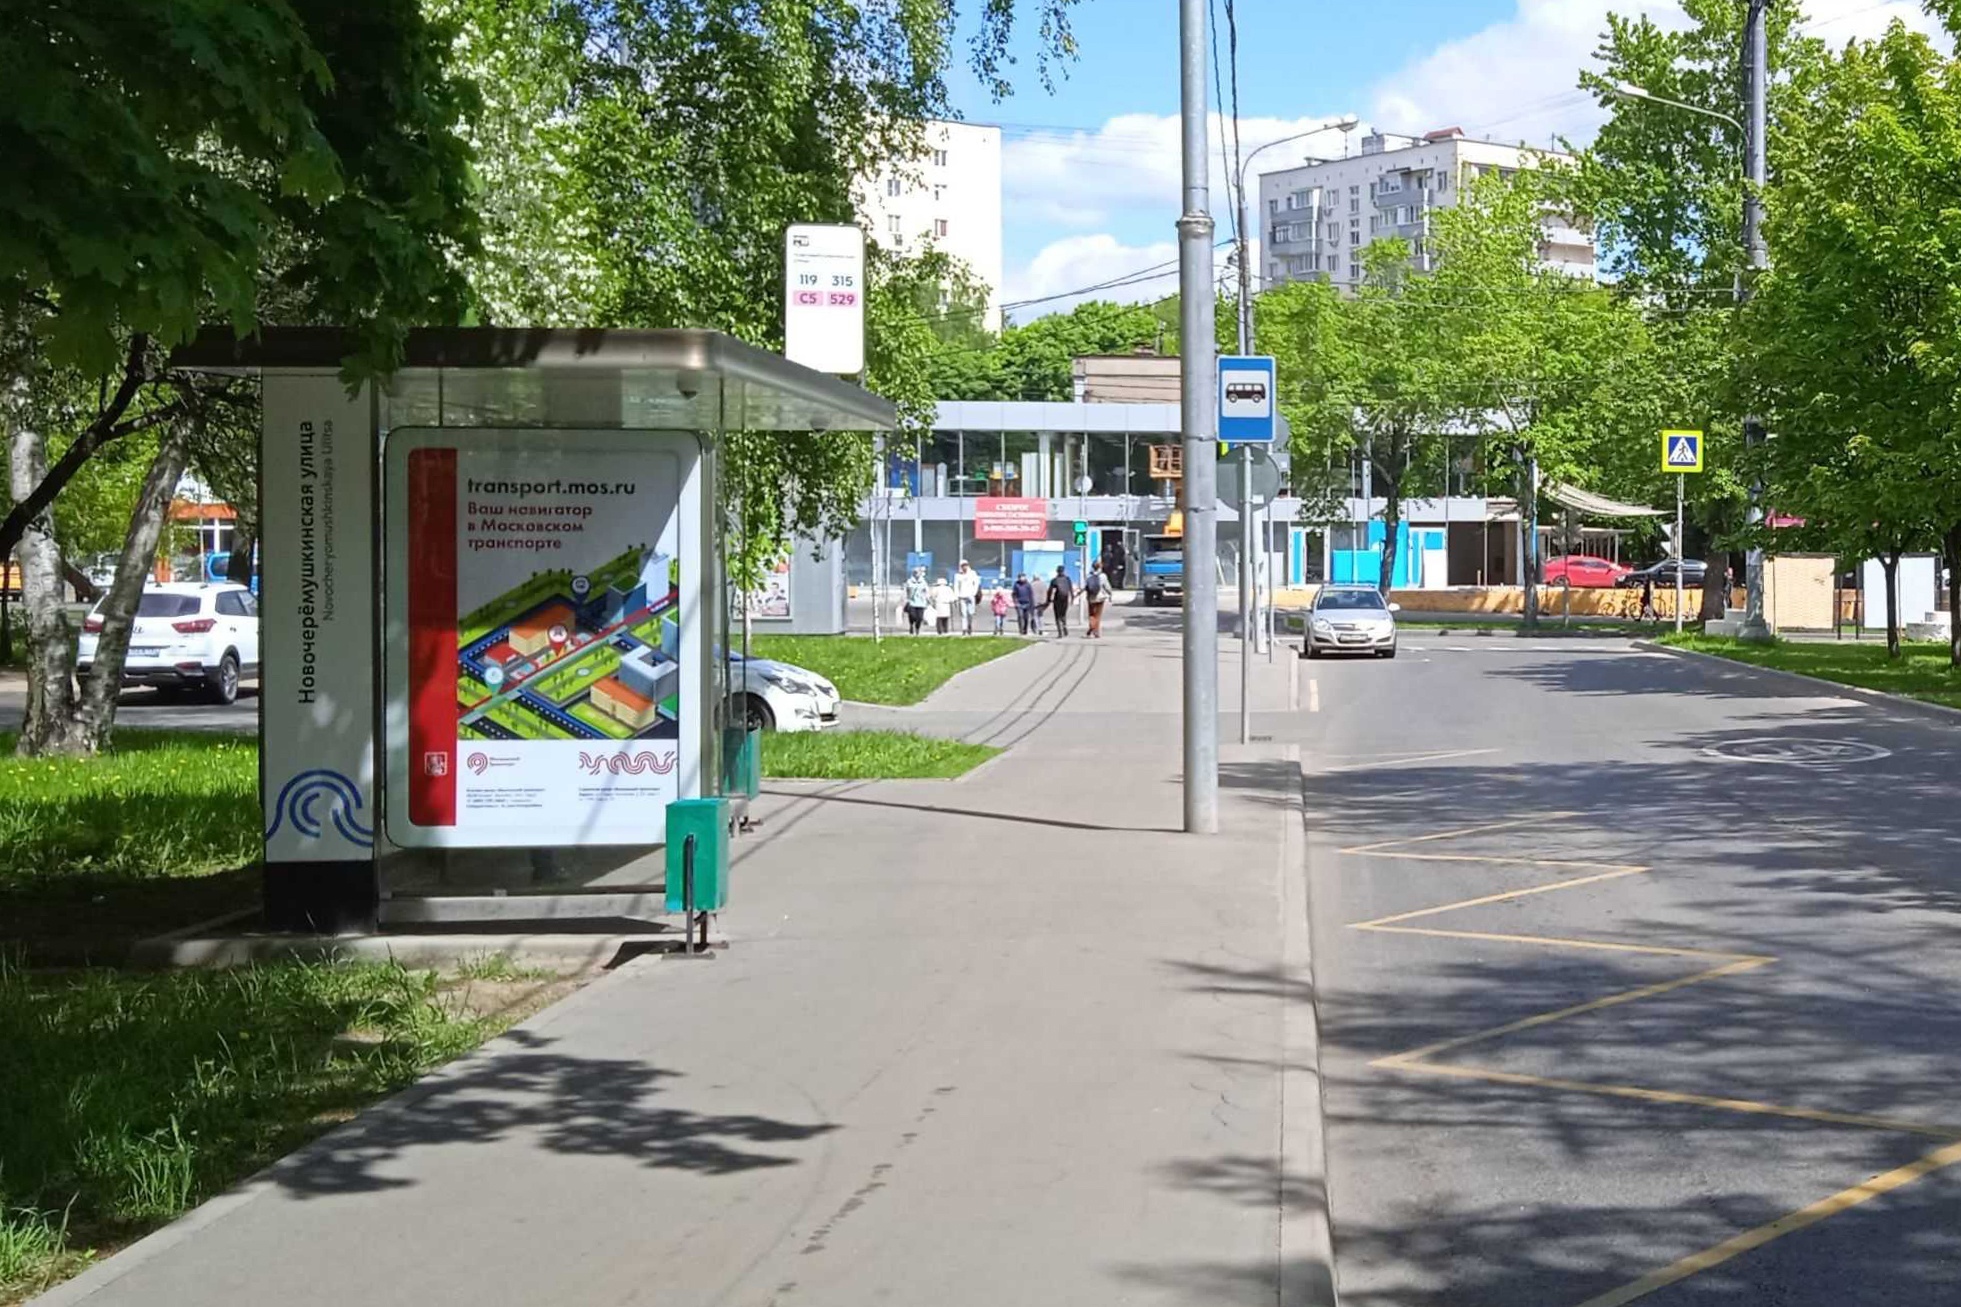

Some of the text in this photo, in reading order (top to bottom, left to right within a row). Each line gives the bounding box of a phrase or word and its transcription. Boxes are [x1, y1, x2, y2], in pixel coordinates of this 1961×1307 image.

[799, 274, 853, 287] 119 315
[830, 294, 855, 305] 529
[467, 478, 636, 498] transport.mos.ru
[468, 502, 592, 518] Ваш навигатор
[468, 519, 584, 532] в Московском
[322, 457, 335, 621] Novocheryomushkinskaya
[468, 538, 562, 552] транспорте
[298, 421, 319, 704] Новочерёмушкинская улица
